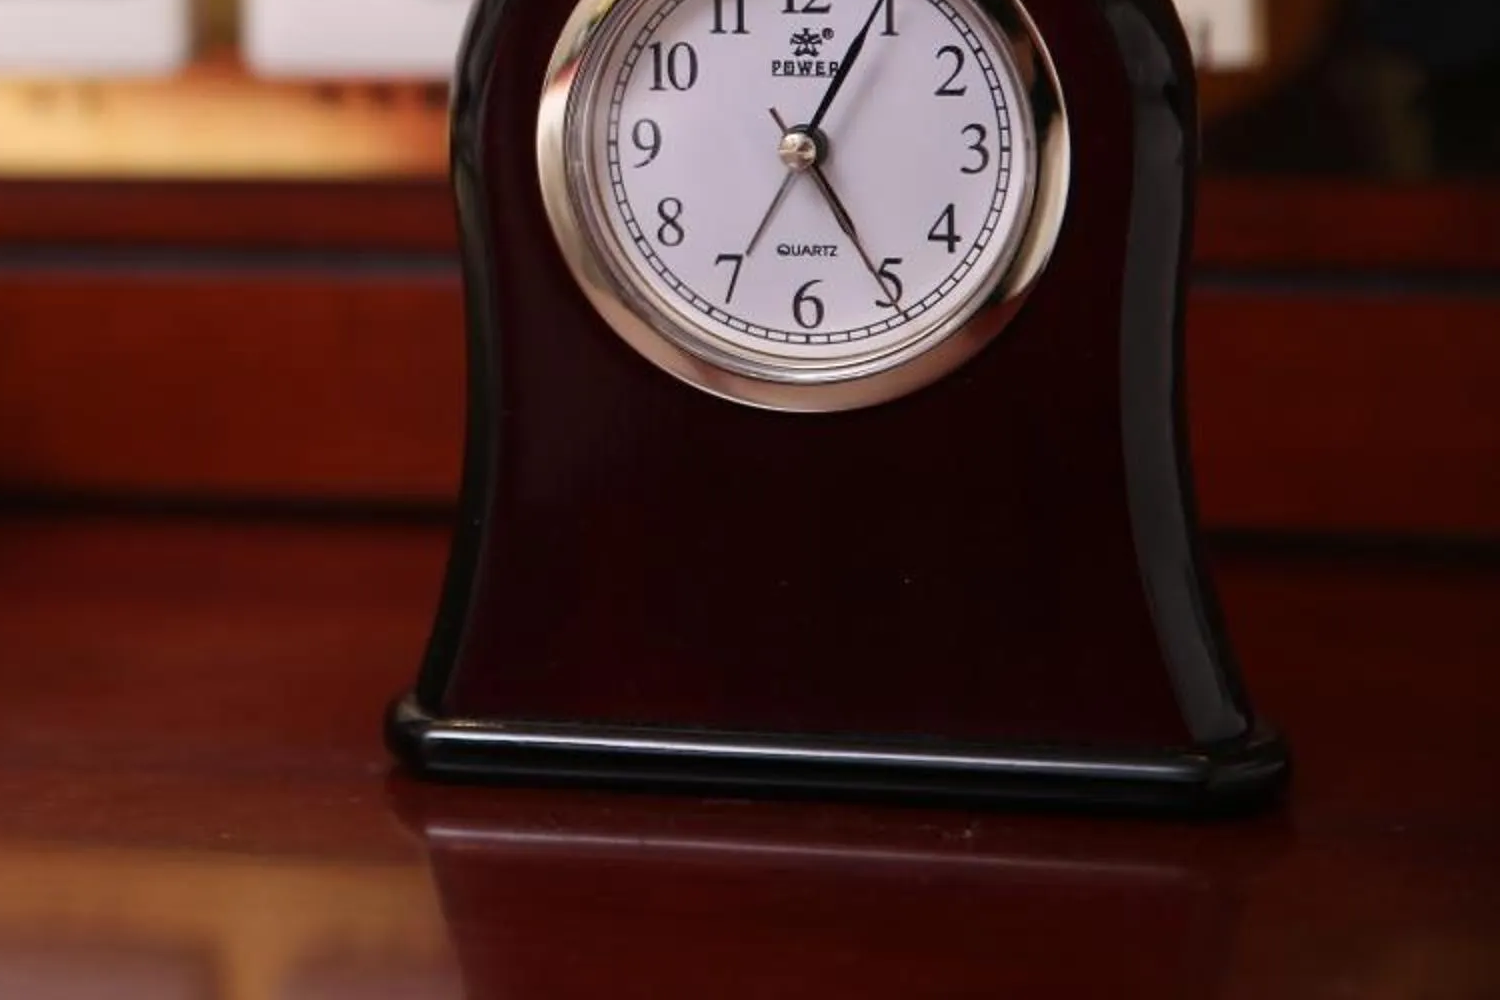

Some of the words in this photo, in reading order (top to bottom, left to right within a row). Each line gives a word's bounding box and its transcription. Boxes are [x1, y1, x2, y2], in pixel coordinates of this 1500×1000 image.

[648, 41, 700, 91] 10
[771, 60, 840, 77] POWER
[934, 45, 968, 97] 2
[631, 118, 662, 169] 9
[960, 123, 990, 174] 3
[656, 197, 685, 247] 8
[927, 203, 962, 254] 4
[776, 243, 838, 258] QUARTZ
[713, 253, 744, 304] 7
[874, 257, 904, 309] 5
[792, 279, 824, 330] 6
